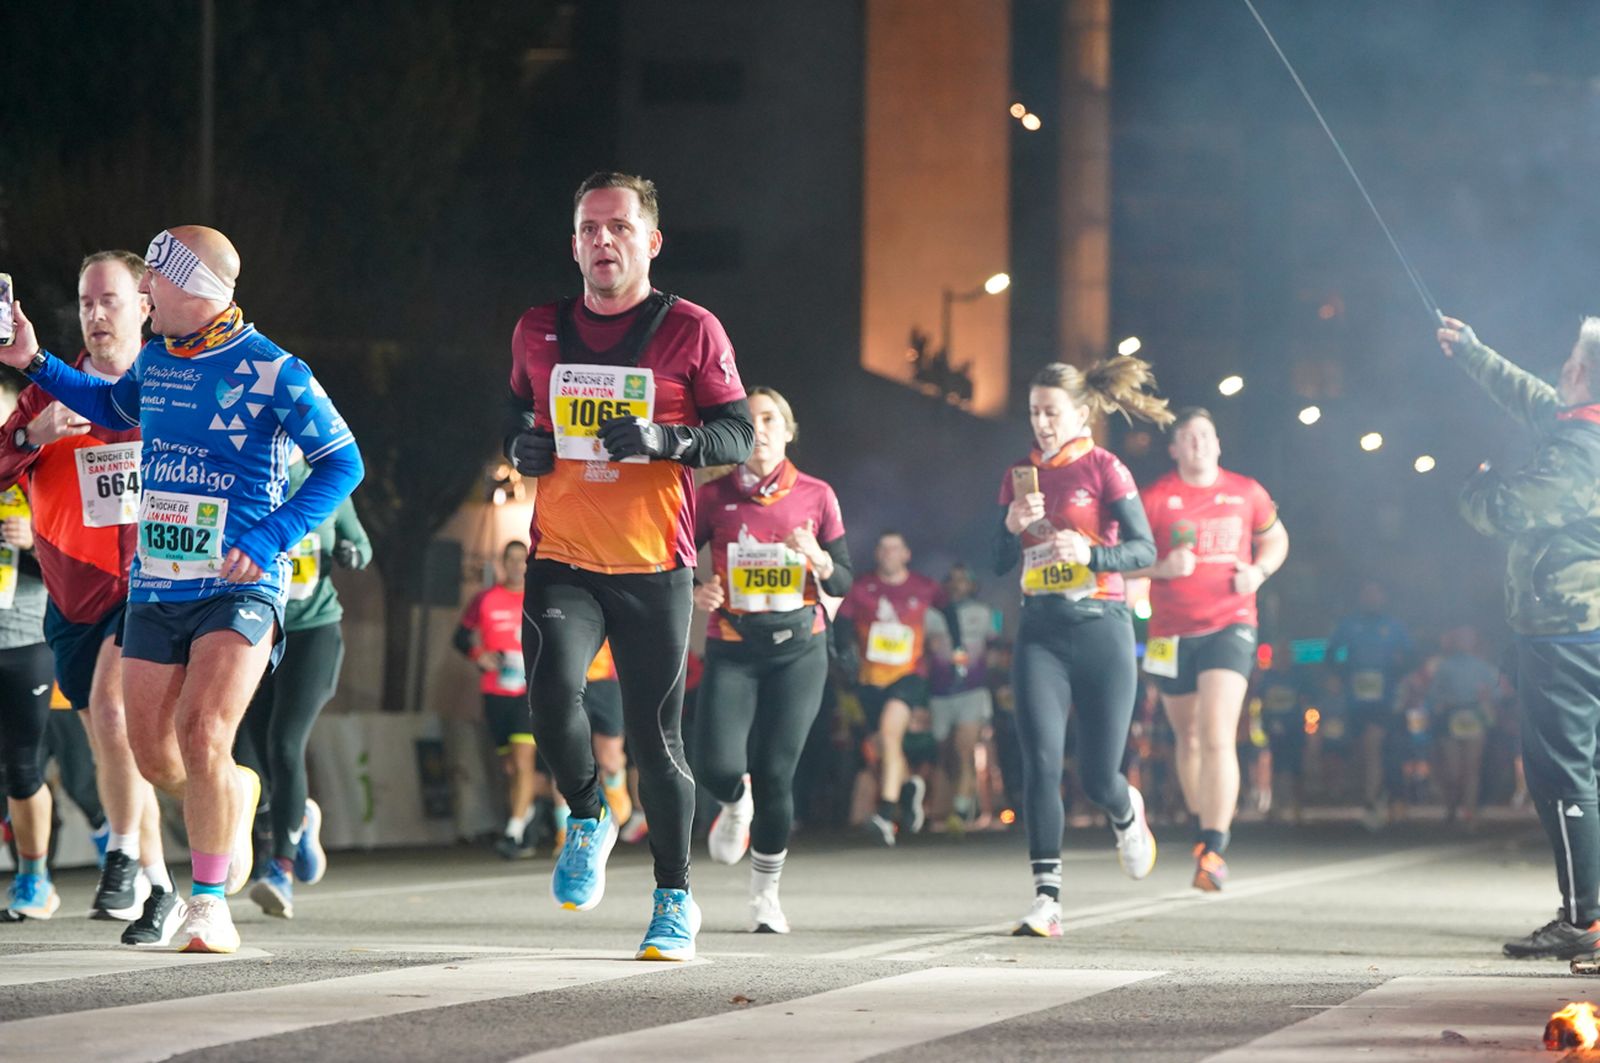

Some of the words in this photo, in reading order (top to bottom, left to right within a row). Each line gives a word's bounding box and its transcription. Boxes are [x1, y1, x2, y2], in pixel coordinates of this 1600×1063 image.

[574, 375, 602, 385] NOCHE
[604, 376, 615, 386] DE
[561, 386, 579, 396] SAN
[569, 399, 631, 427] 1065
[97, 452, 123, 463] NOCHE
[125, 450, 135, 460] DE
[88, 464, 106, 475] SAN
[97, 472, 140, 498] 664
[178, 503, 190, 513] DE
[144, 523, 211, 554] 13302
[744, 568, 791, 588] 7560
[1042, 563, 1073, 586] 195
